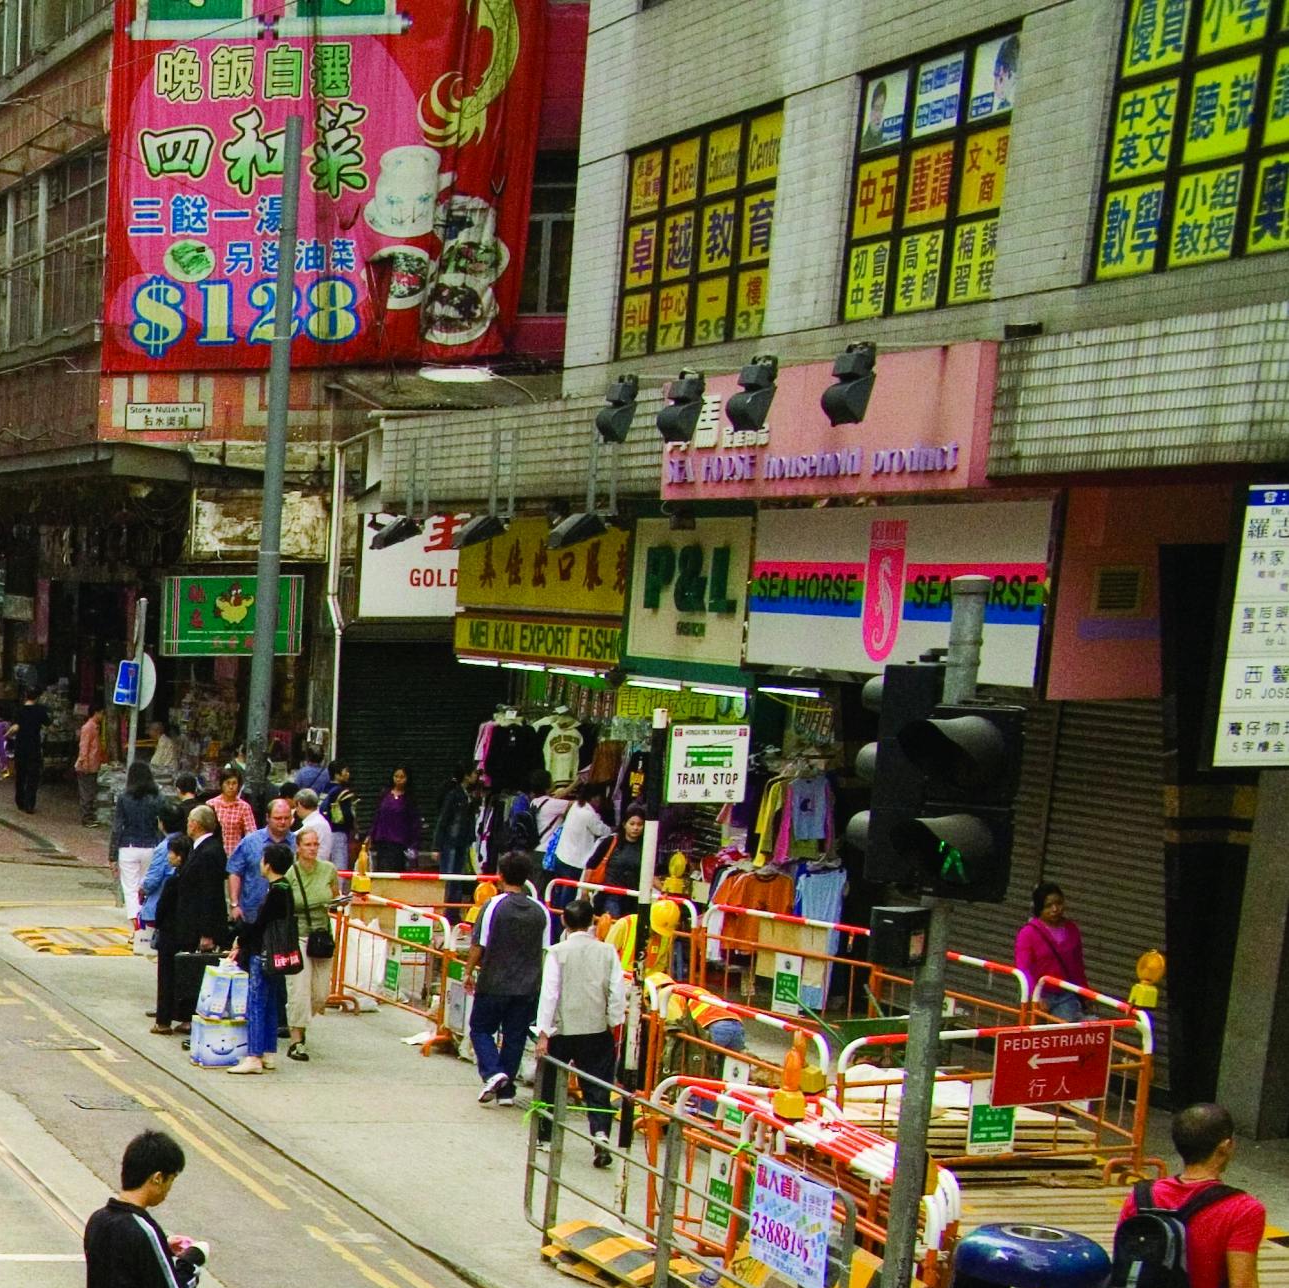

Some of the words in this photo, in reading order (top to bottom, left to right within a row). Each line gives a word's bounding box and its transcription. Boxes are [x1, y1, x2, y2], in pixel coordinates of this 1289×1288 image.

[156, 44, 352, 101] 晚飯自選
[1120, 85, 1176, 131] 中文
[1114, 126, 1171, 174] 英文
[1180, 169, 1241, 217] 小組
[1173, 211, 1234, 259] 教授
[129, 275, 360, 359] $128
[701, 453, 756, 483] HORSE
[871, 441, 959, 477] product
[643, 543, 739, 615] P&L
[757, 571, 789, 601] SEA
[793, 572, 858, 605] HORSE
[912, 574, 953, 609] SEA
[469, 620, 489, 649] MEI
[493, 622, 515, 650] KAI
[519, 623, 573, 657] EXPORT
[677, 772, 705, 785] TRAM
[712, 772, 739, 785] STOP
[1003, 1032, 1105, 1053] PEDESTRIANS
[1028, 1075, 1071, 1098] 行人
